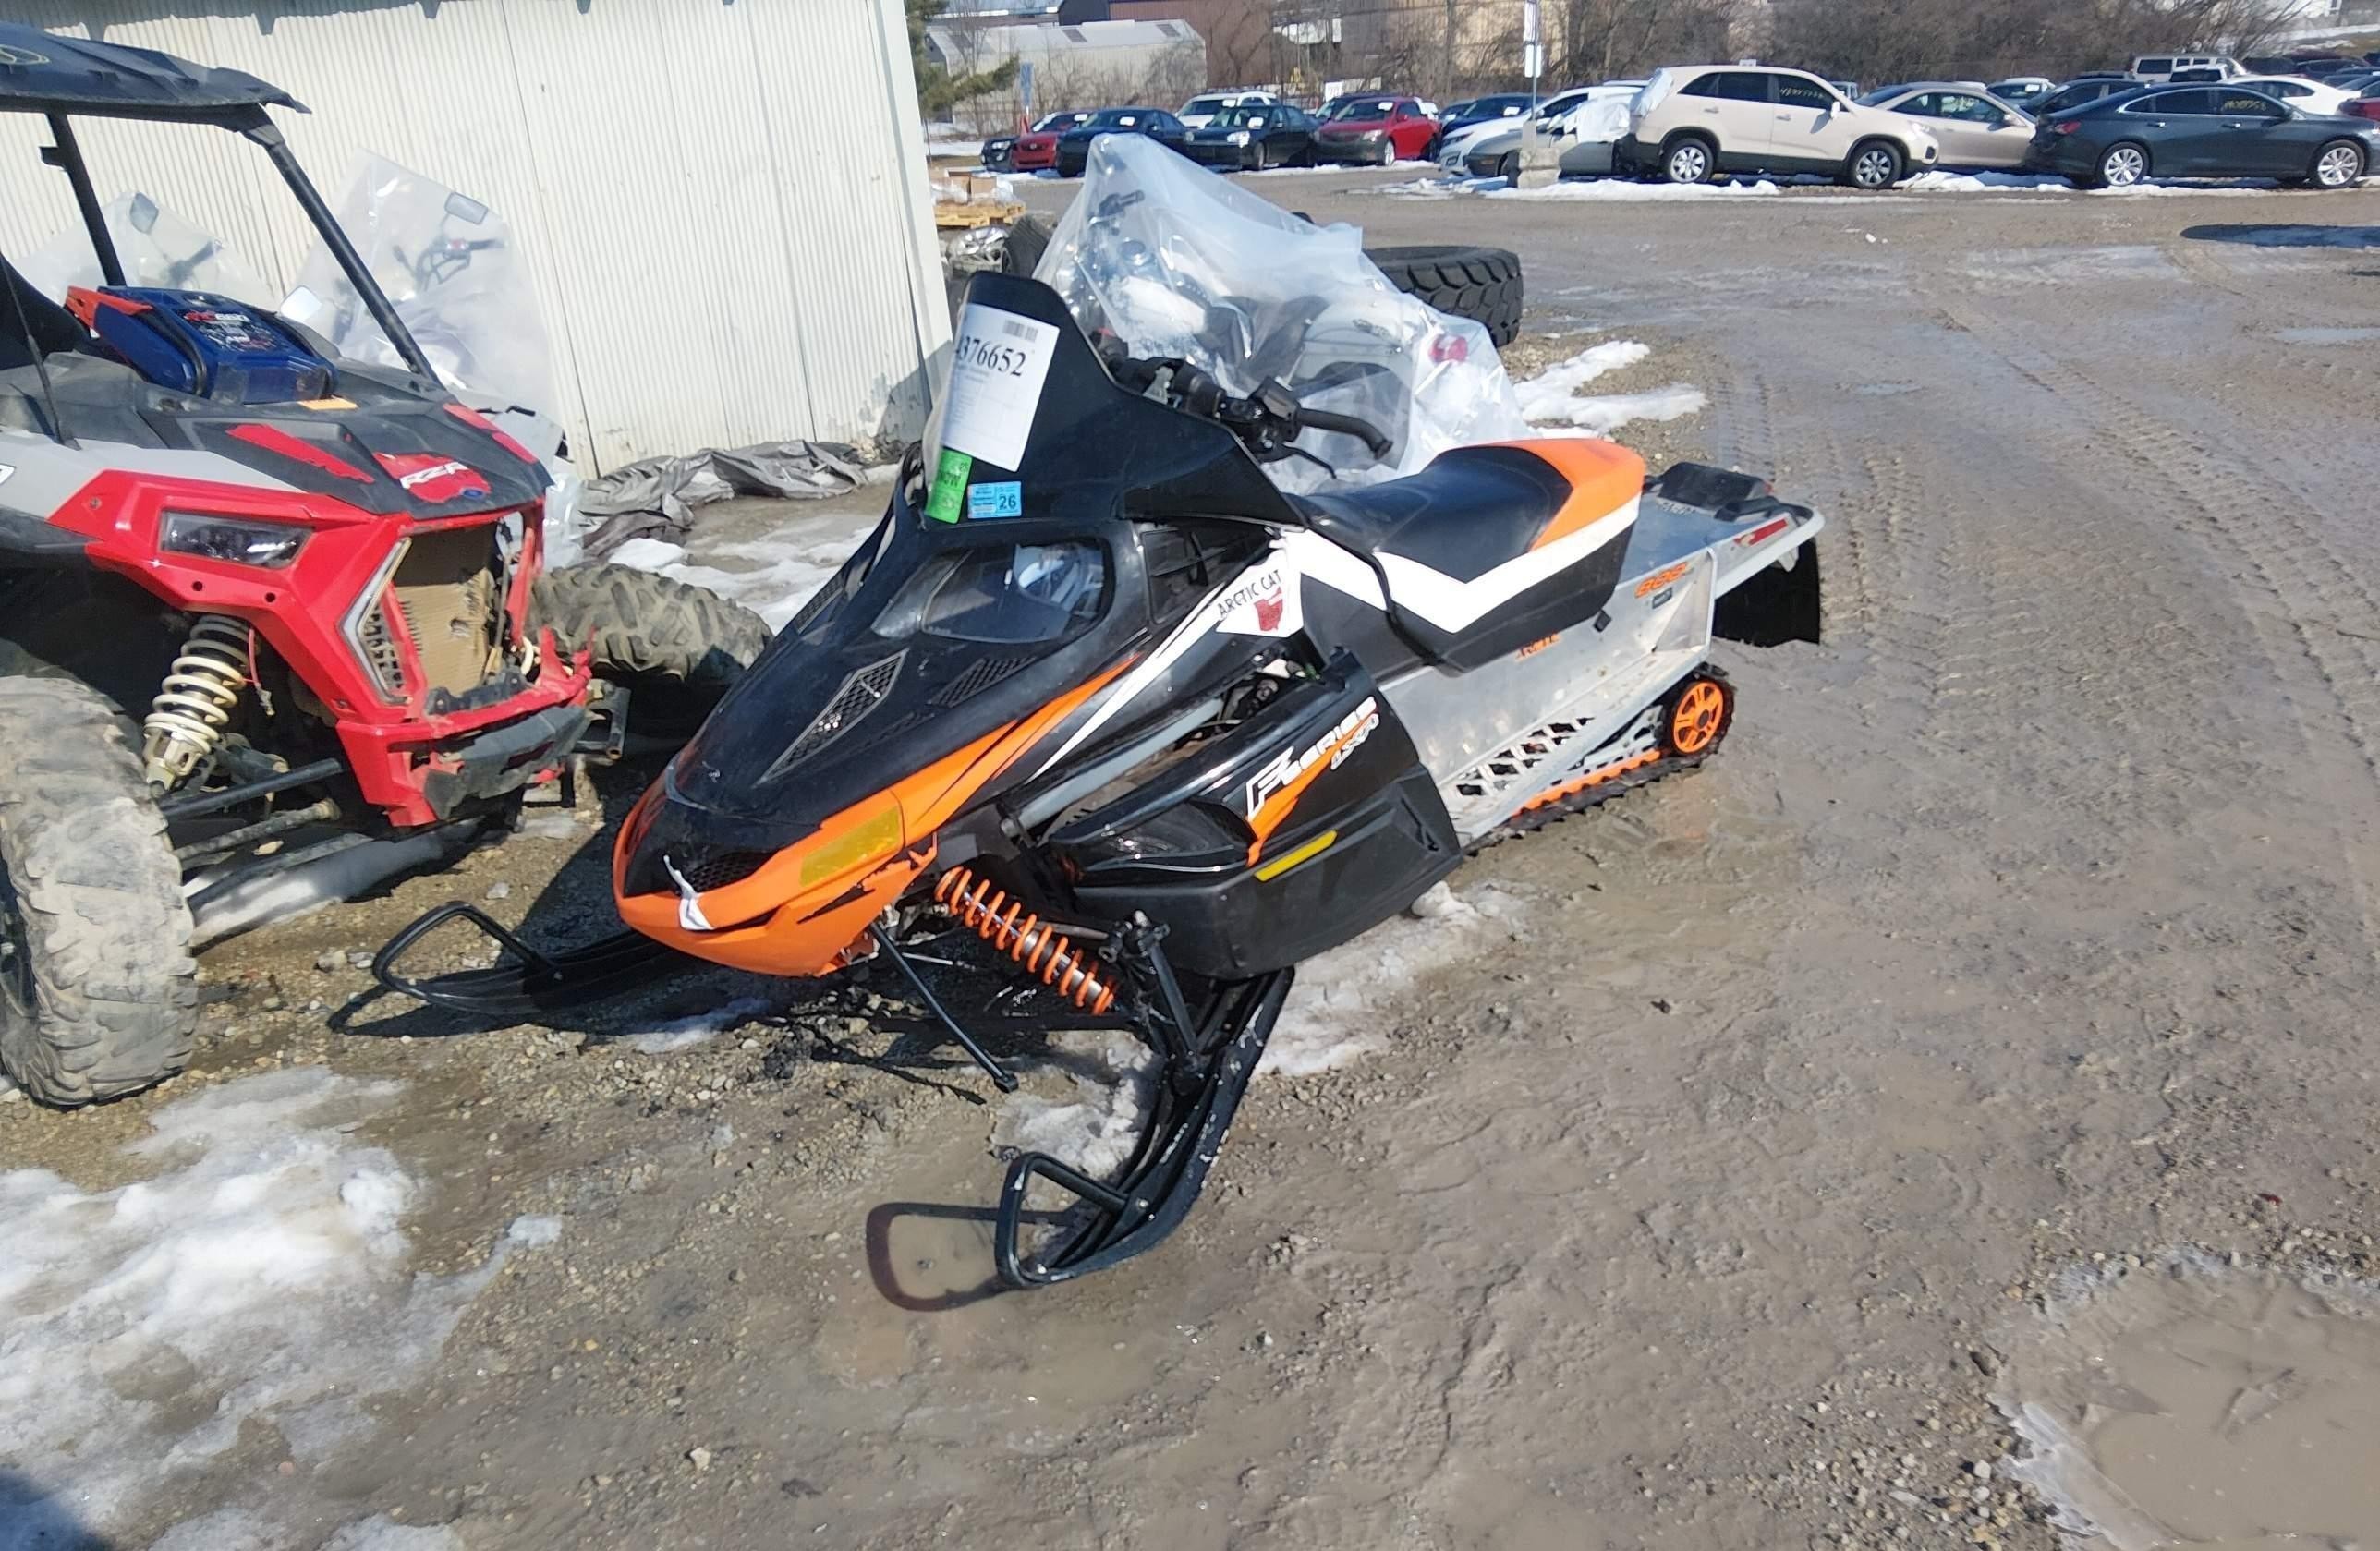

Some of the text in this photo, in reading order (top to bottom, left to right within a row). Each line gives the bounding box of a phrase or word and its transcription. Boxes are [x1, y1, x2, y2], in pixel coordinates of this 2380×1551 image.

[399, 461, 470, 490] RZR
[998, 493, 1017, 511] 26
[1217, 568, 1282, 618] ARCTIC CAT
